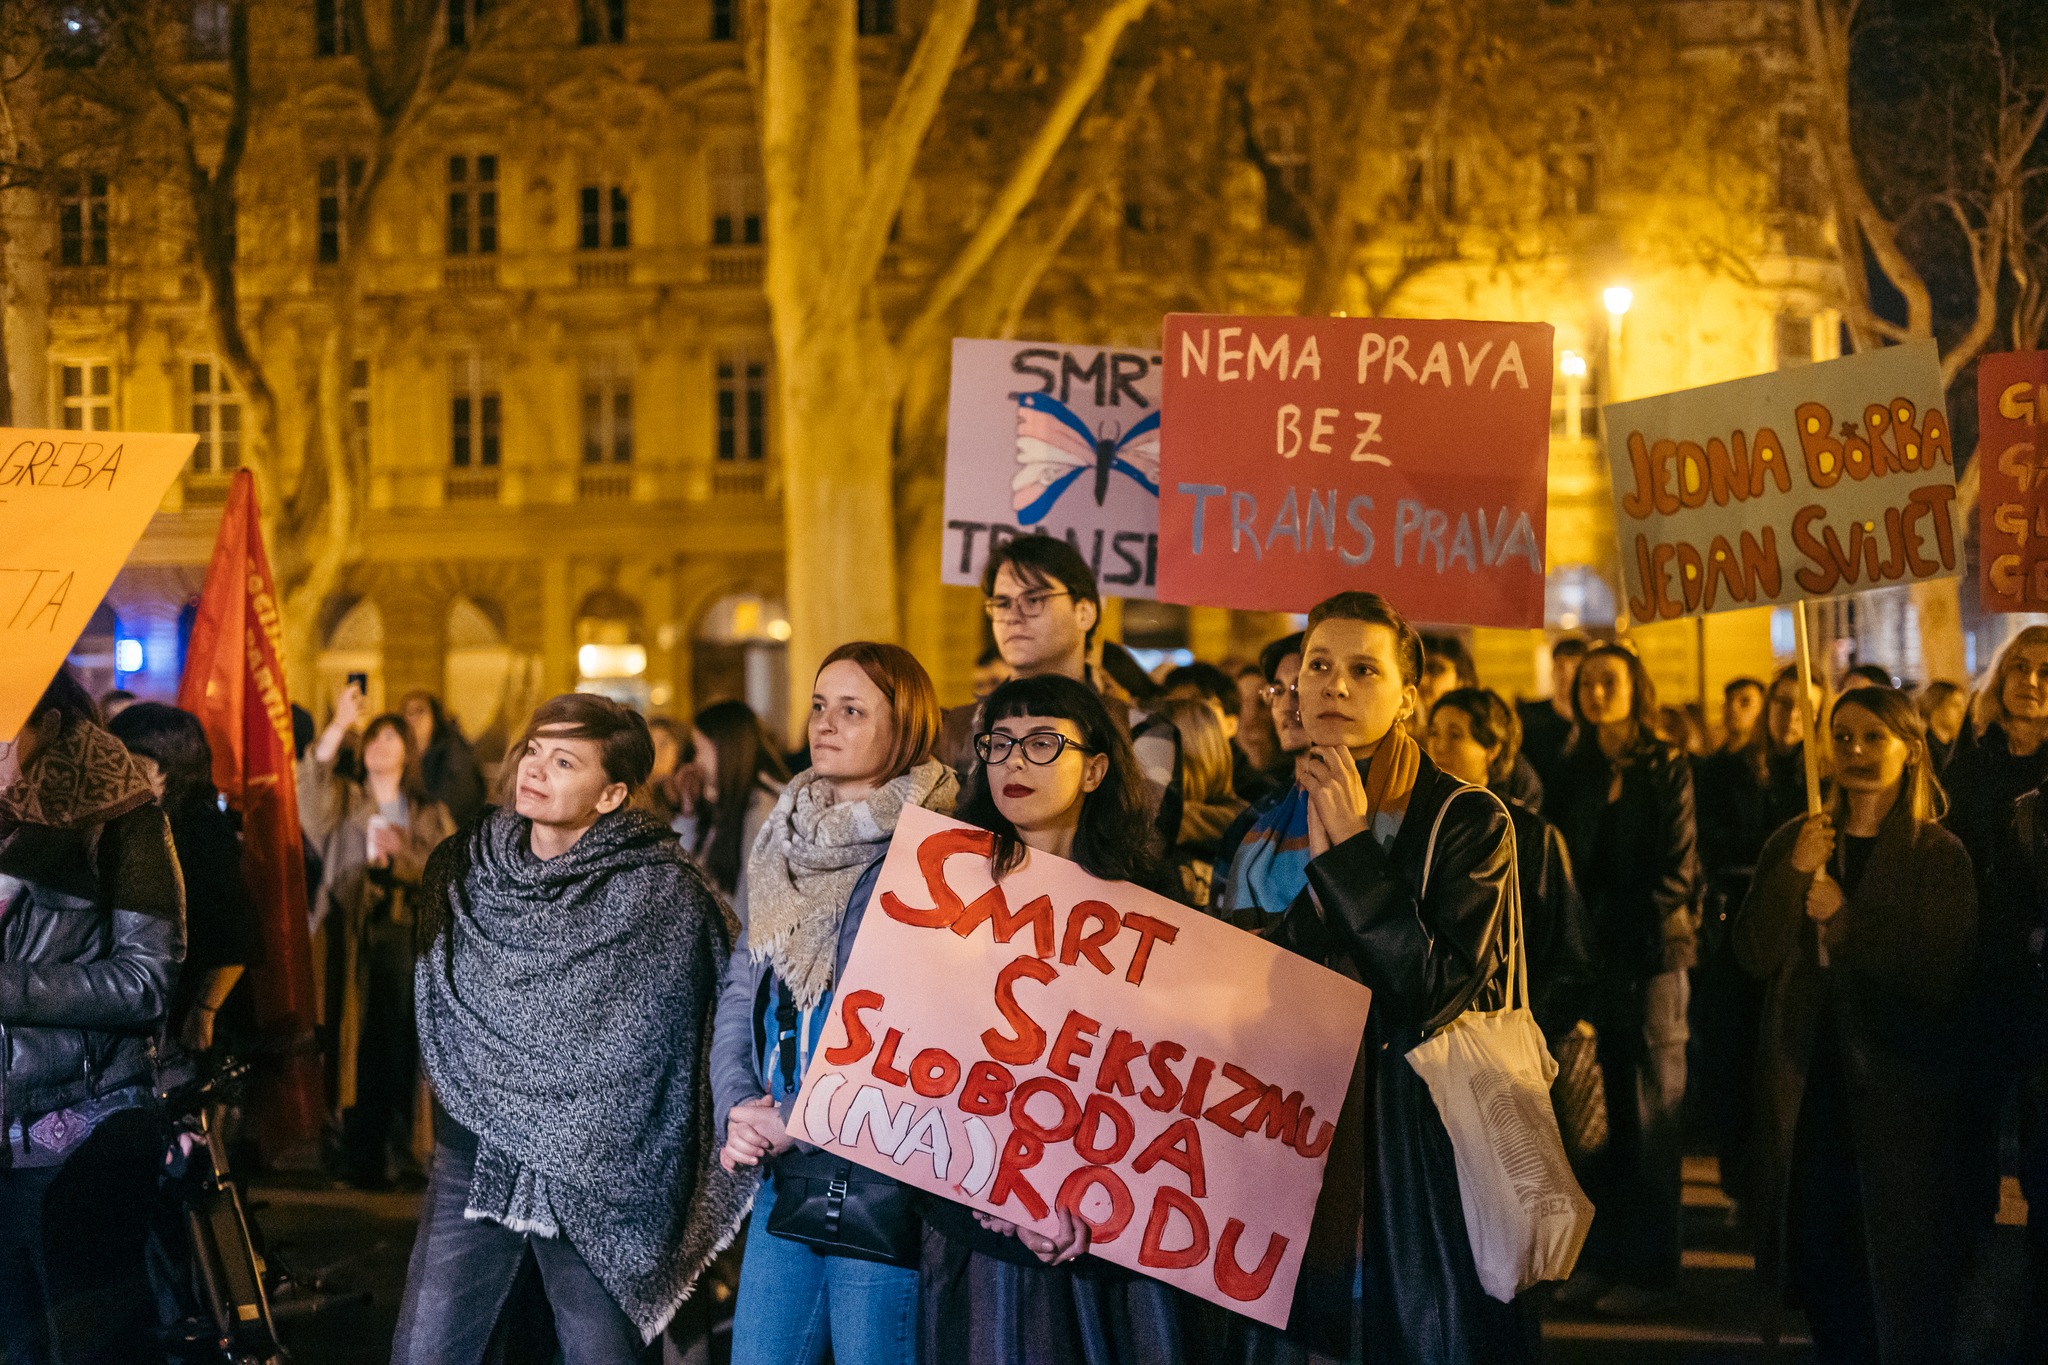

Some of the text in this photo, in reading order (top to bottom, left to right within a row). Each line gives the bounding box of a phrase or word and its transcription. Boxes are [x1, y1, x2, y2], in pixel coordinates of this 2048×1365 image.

[1008, 348, 1162, 408] SMR
[1181, 326, 1529, 390] NEMA PRAVA
[1277, 404, 1392, 467] BEZ
[1622, 397, 1953, 520] JEDNA BORBA
[1178, 483, 1542, 574] TRANS PRAVA
[1631, 525, 1782, 624] JEDAN
[0, 568, 74, 632] TA
[880, 828, 1180, 987] SMRT
[825, 989, 1208, 1198] SLOBODA
[980, 954, 1335, 1158] SEKSIZMU
